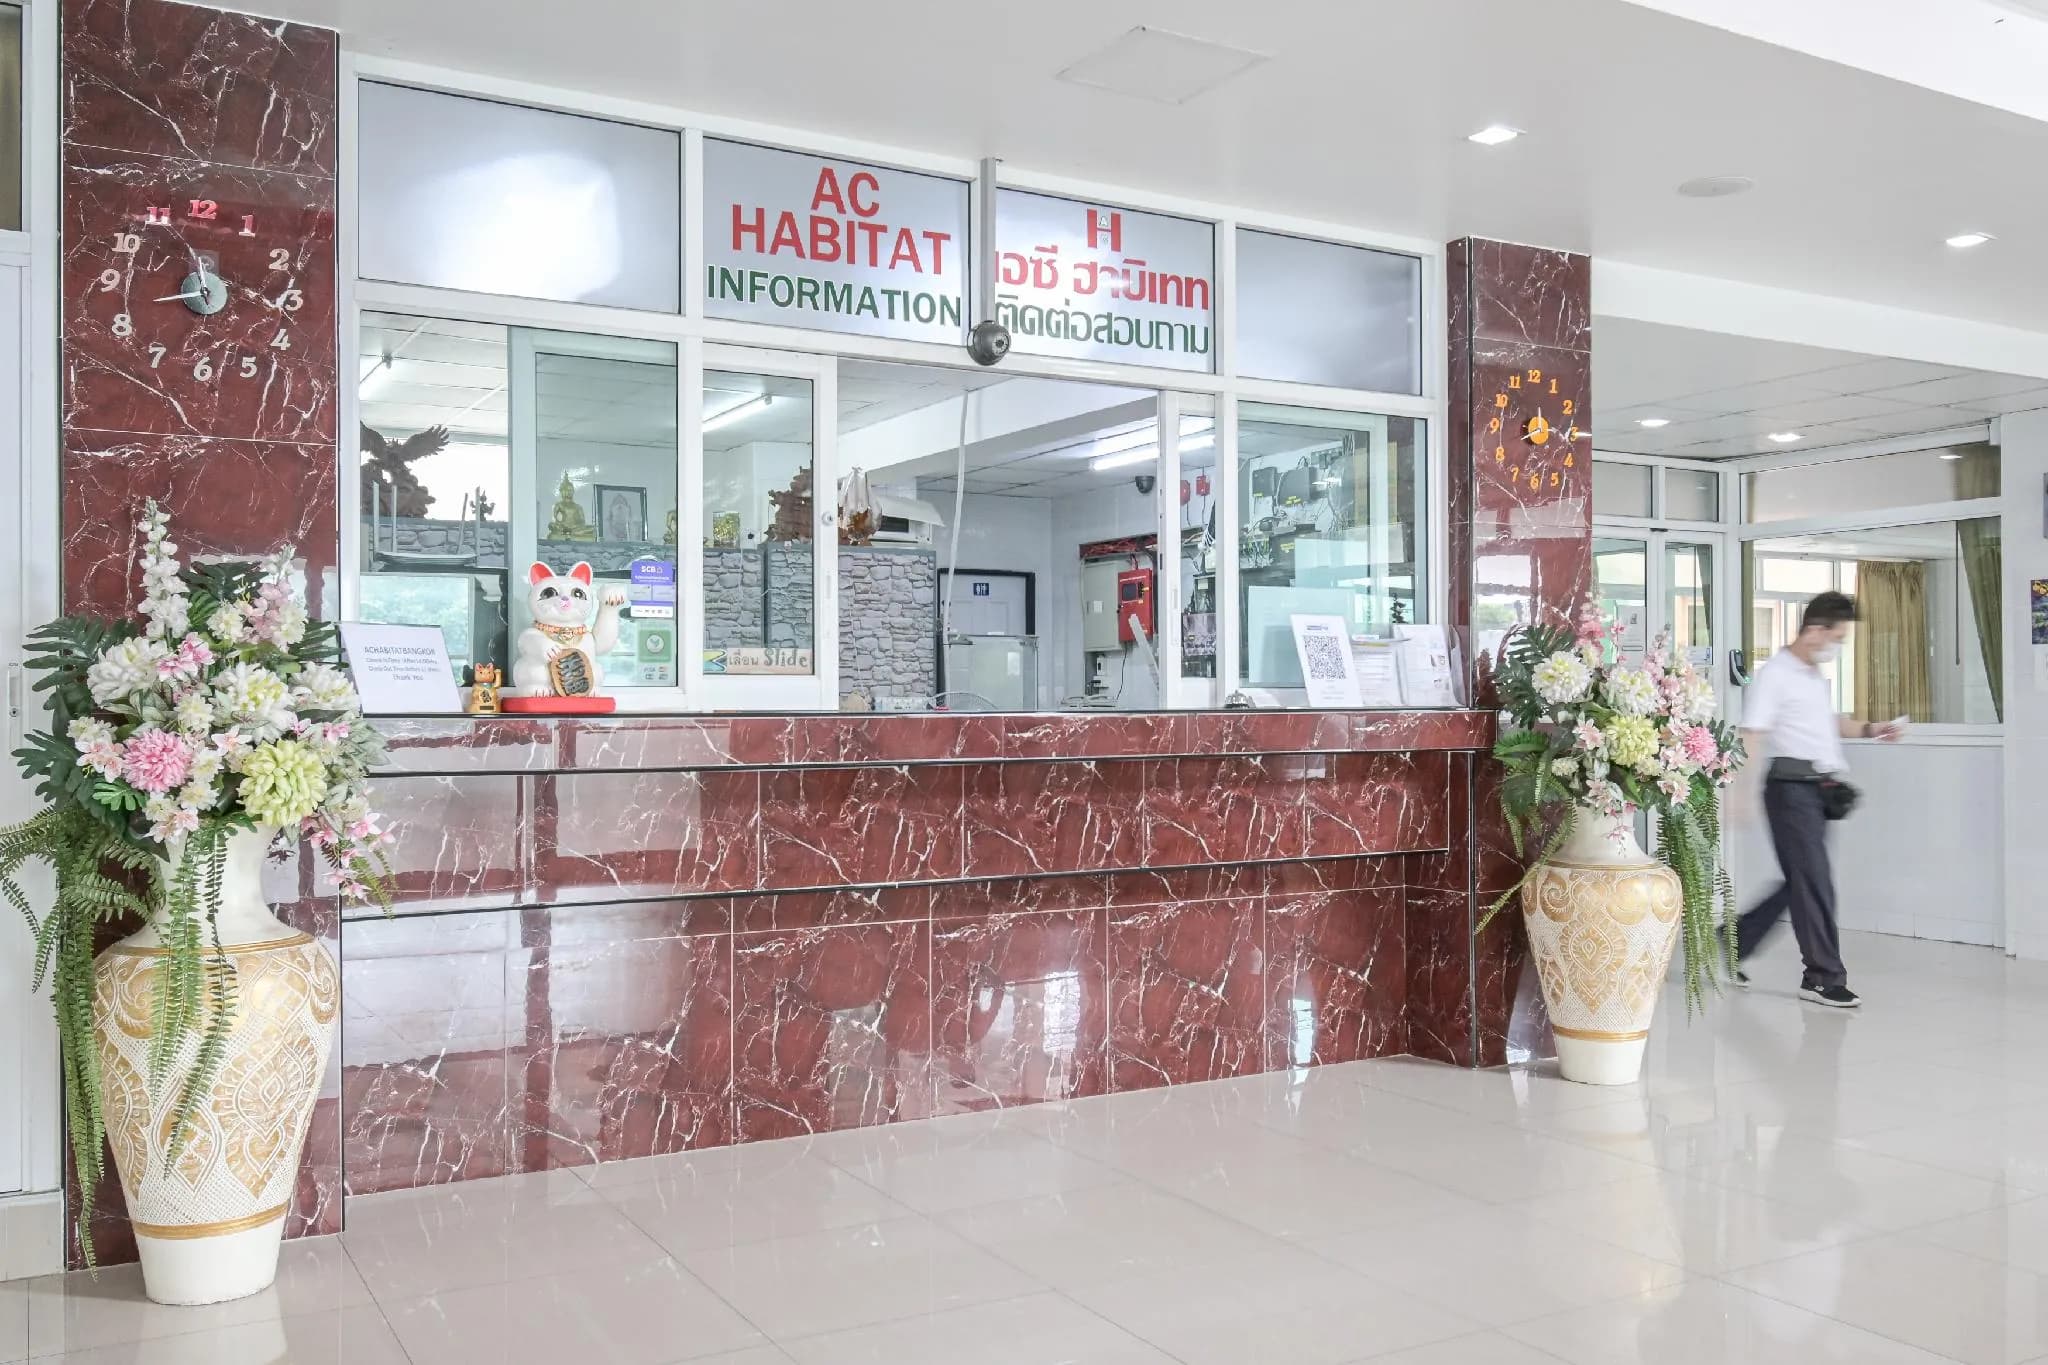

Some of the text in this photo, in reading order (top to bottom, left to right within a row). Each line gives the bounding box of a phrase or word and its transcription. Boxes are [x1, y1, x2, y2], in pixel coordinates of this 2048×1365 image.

[811, 167, 880, 217] AC
[145, 206, 171, 226] 11
[188, 200, 217, 220] 12
[239, 214, 256, 238] 1
[112, 233, 140, 253] 10
[732, 204, 951, 276] HABITAT
[269, 248, 288, 271] 2
[100, 269, 120, 292] 9
[285, 289, 303, 311] 3
[707, 265, 961, 327] INFORMATION
[112, 313, 133, 337] 8
[995, 294, 1209, 354] ติดต่อสอบถาม
[270, 328, 291, 350] 4
[148, 346, 166, 368] 7
[193, 360, 213, 382] 6
[239, 357, 257, 378] 5
[1527, 369, 1542, 384] 12
[1508, 375, 1521, 389] 11
[1549, 379, 1558, 394] 1
[1494, 393, 1508, 408] 10
[1562, 399, 1573, 415] 2
[1489, 418, 1500, 434] 9
[1495, 446, 1505, 462] 8
[1563, 453, 1573, 467] 4
[1511, 467, 1519, 483] 7
[1530, 475, 1539, 490] 6
[1550, 472, 1559, 487] 5
[764, 648, 808, 668] Slide
